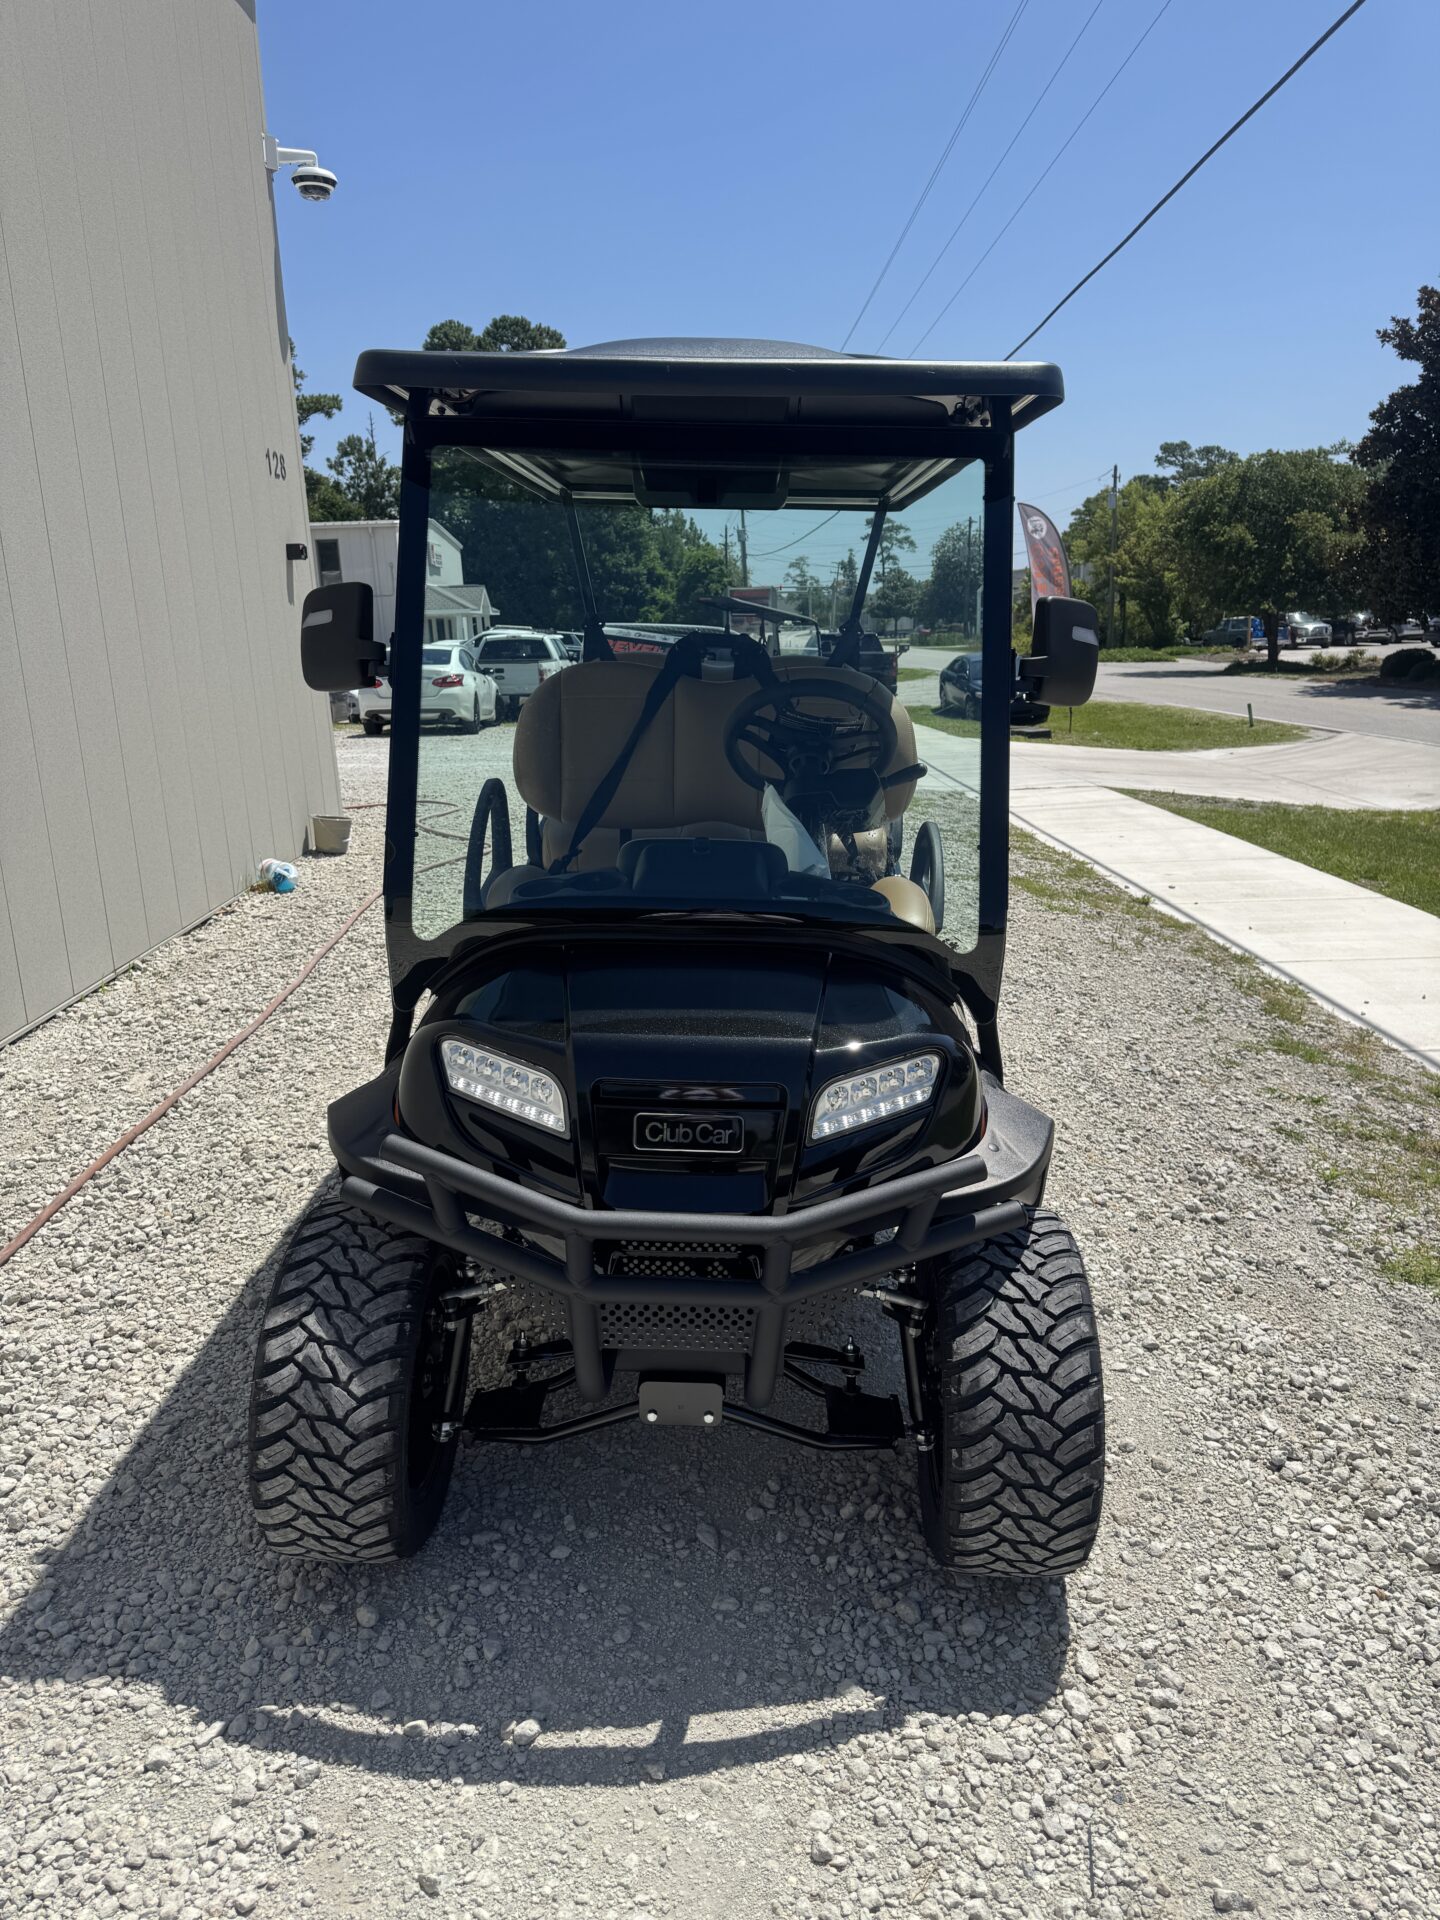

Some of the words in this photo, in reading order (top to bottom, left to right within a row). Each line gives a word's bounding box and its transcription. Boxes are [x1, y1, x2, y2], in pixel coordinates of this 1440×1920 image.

[265, 447, 287, 481] 128
[645, 1121, 693, 1143] Club
[695, 1123, 733, 1144] Car
